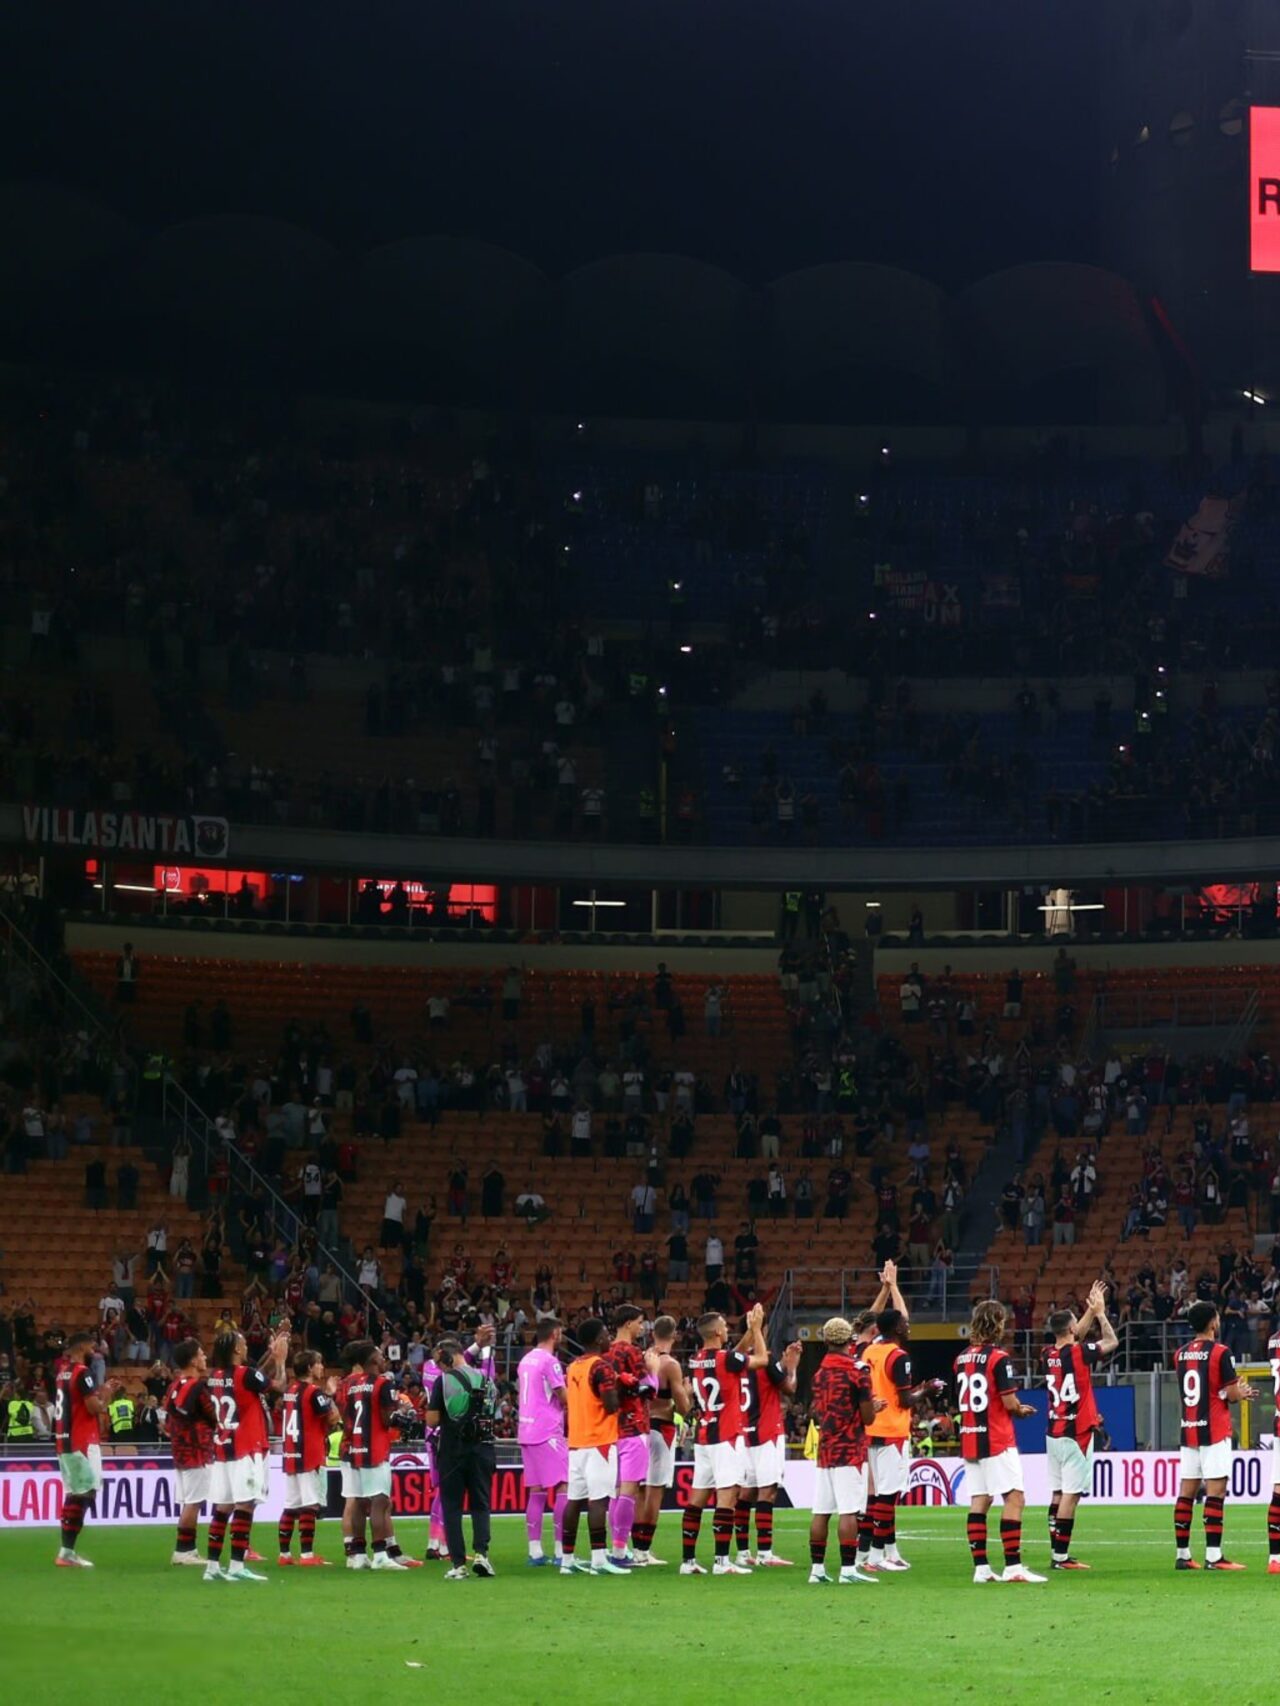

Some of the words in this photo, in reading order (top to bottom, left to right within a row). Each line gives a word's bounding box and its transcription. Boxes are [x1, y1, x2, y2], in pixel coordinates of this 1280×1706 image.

[23, 806, 193, 854] VILLASANTA
[957, 1372, 989, 1413] 28
[1045, 1373, 1080, 1408] 34
[1184, 1369, 1201, 1407] 9
[353, 1400, 363, 1434] 2
[1122, 1458, 1145, 1498] 18
